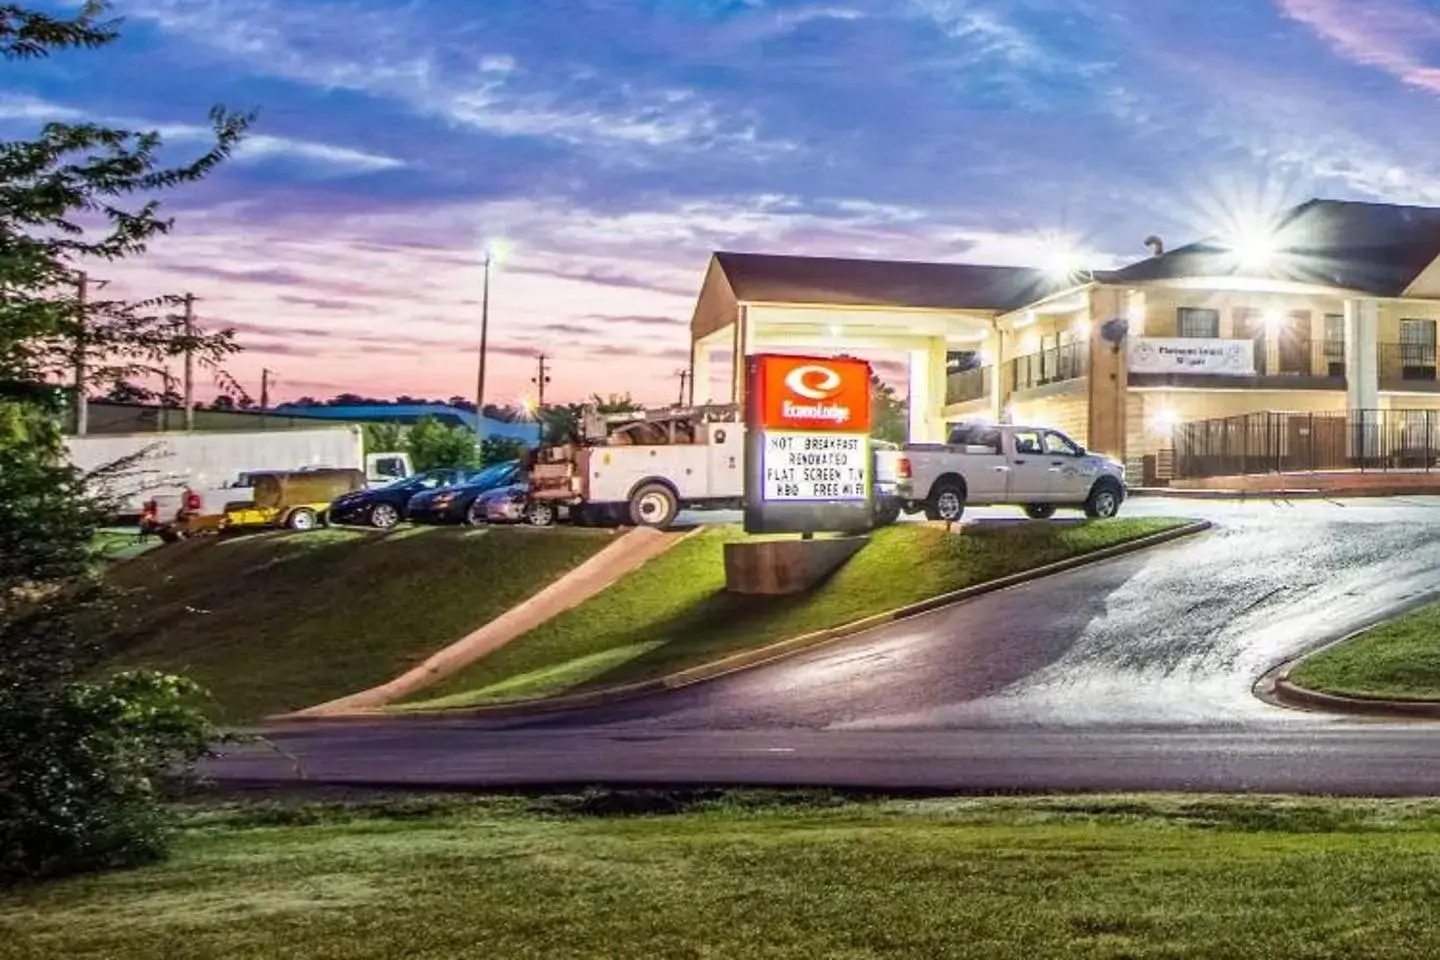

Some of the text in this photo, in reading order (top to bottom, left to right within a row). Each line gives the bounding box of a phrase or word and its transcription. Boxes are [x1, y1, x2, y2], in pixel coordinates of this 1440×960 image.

[804, 438, 859, 450] BREAKFAST
[788, 453, 848, 465] RENOVATED
[767, 468, 794, 480] FLAT
[803, 468, 841, 480] SCREEN
[813, 484, 839, 496] FREE
